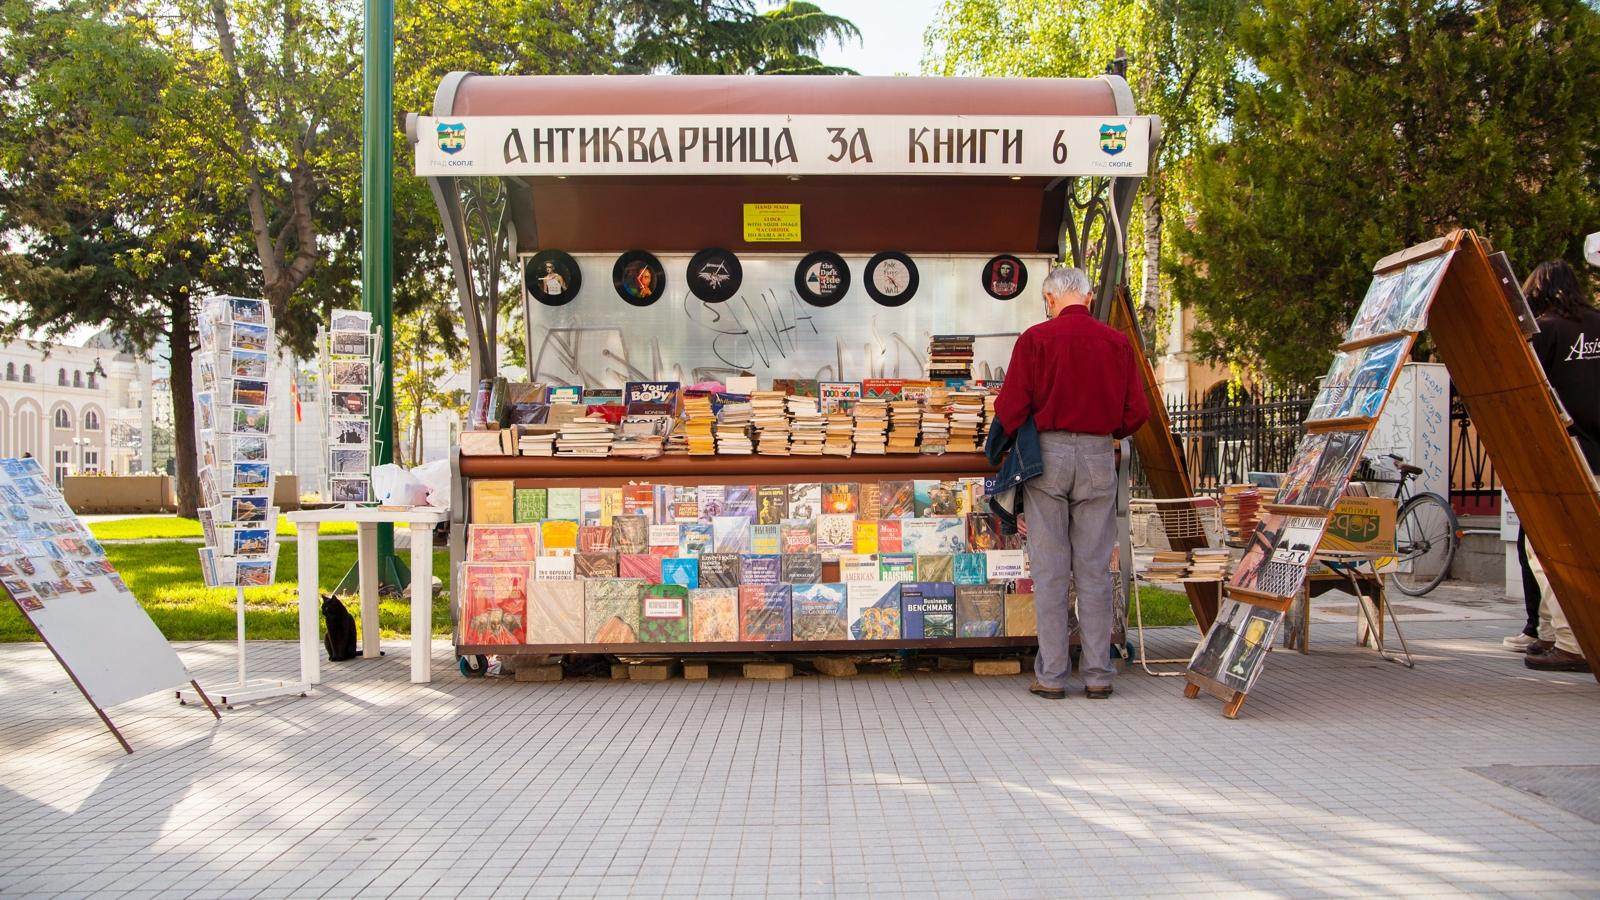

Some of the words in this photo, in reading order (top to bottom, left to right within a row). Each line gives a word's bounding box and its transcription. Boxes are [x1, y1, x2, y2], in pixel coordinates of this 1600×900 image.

[503, 125, 799, 167] АНТИКВАРНИЦА
[825, 126, 873, 165] ЗА
[908, 125, 1023, 165] КНИГИ
[1052, 129, 1068, 165] 6
[907, 604, 953, 612] BENCHMARK
